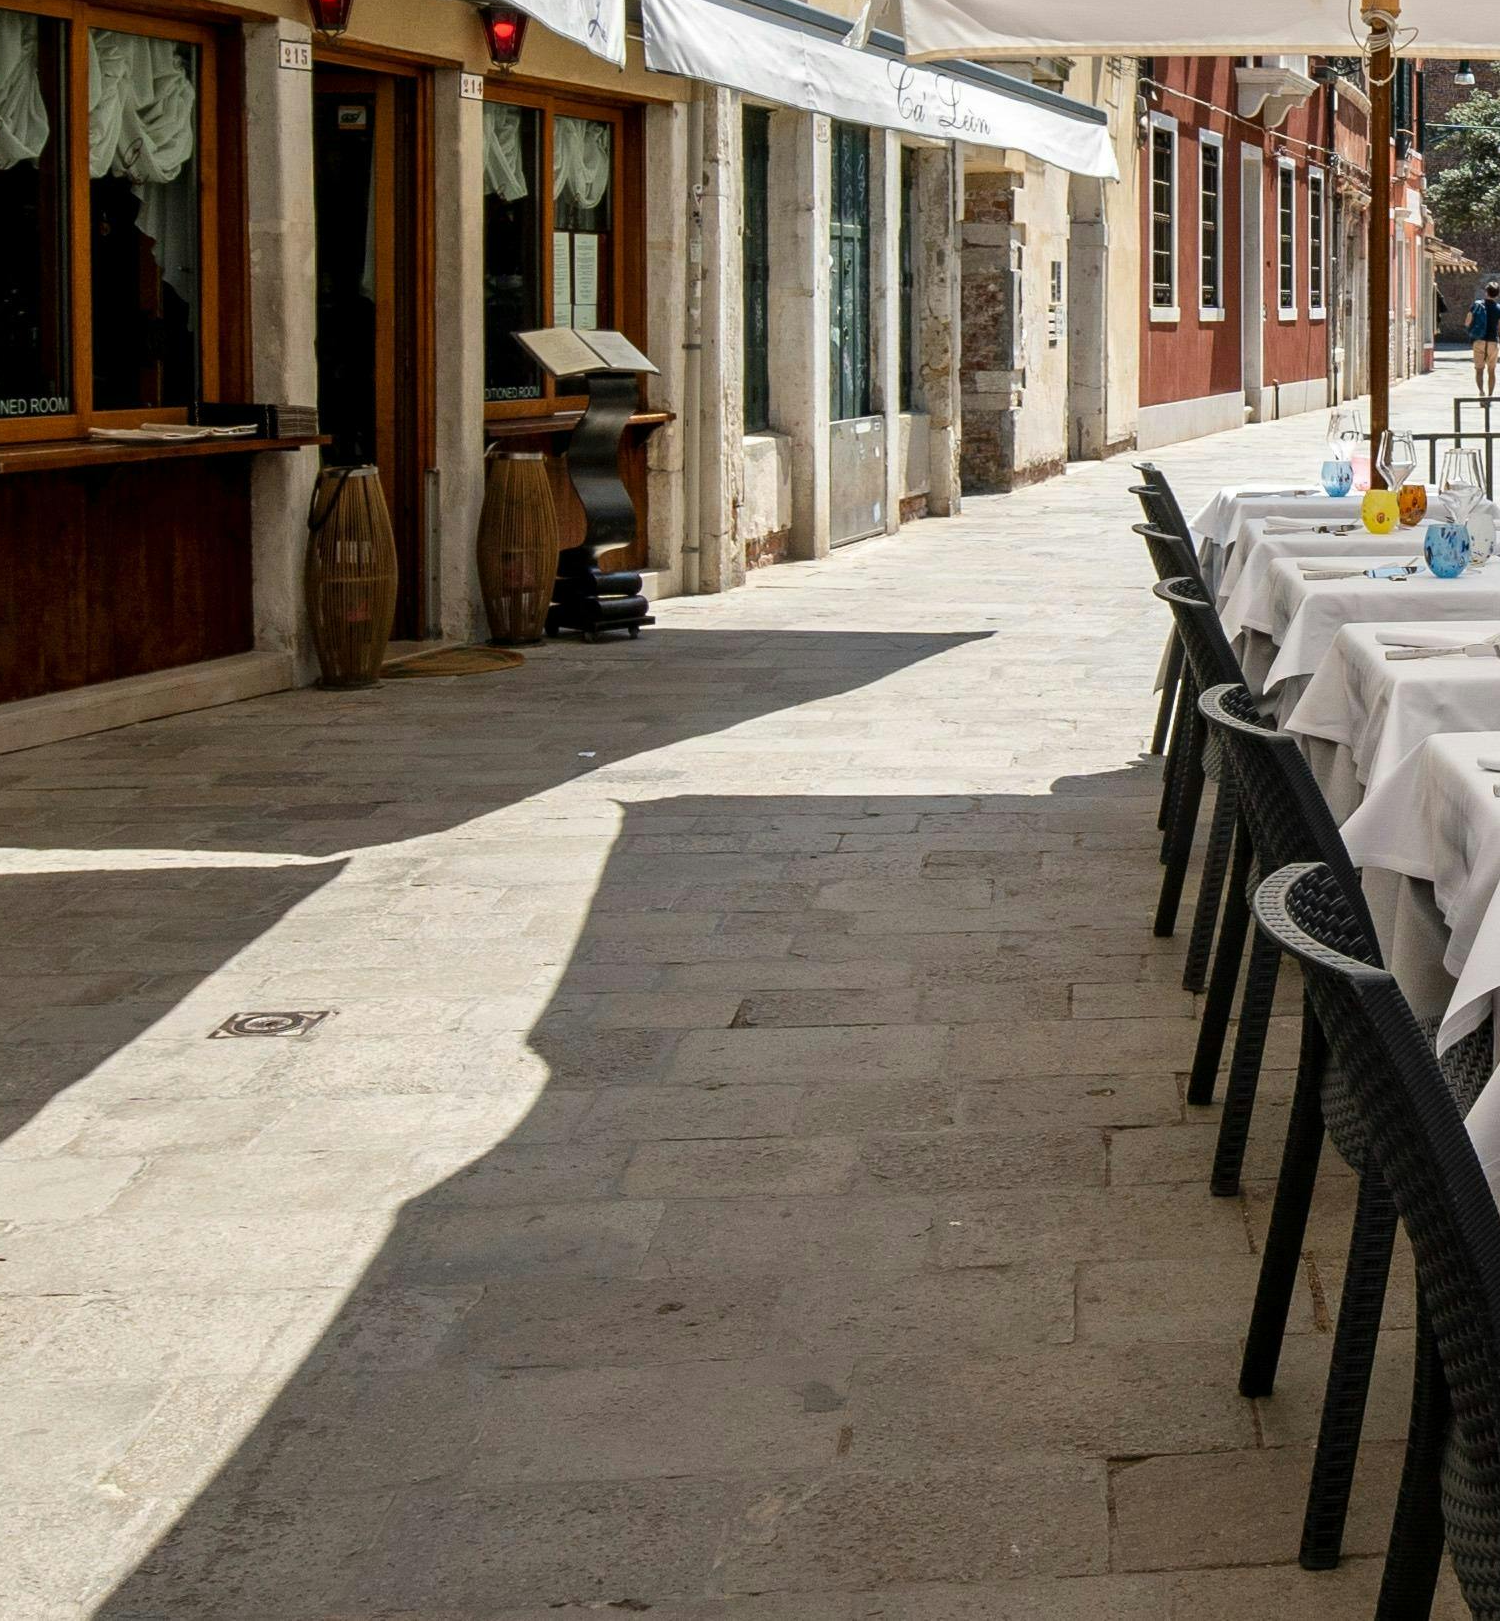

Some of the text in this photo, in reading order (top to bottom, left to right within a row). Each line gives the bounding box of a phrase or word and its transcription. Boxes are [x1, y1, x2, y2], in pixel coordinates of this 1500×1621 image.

[284, 47, 308, 65] 215
[462, 79, 484, 96] 214
[886, 58, 926, 122] Ca'
[30, 396, 70, 414] ROOM
